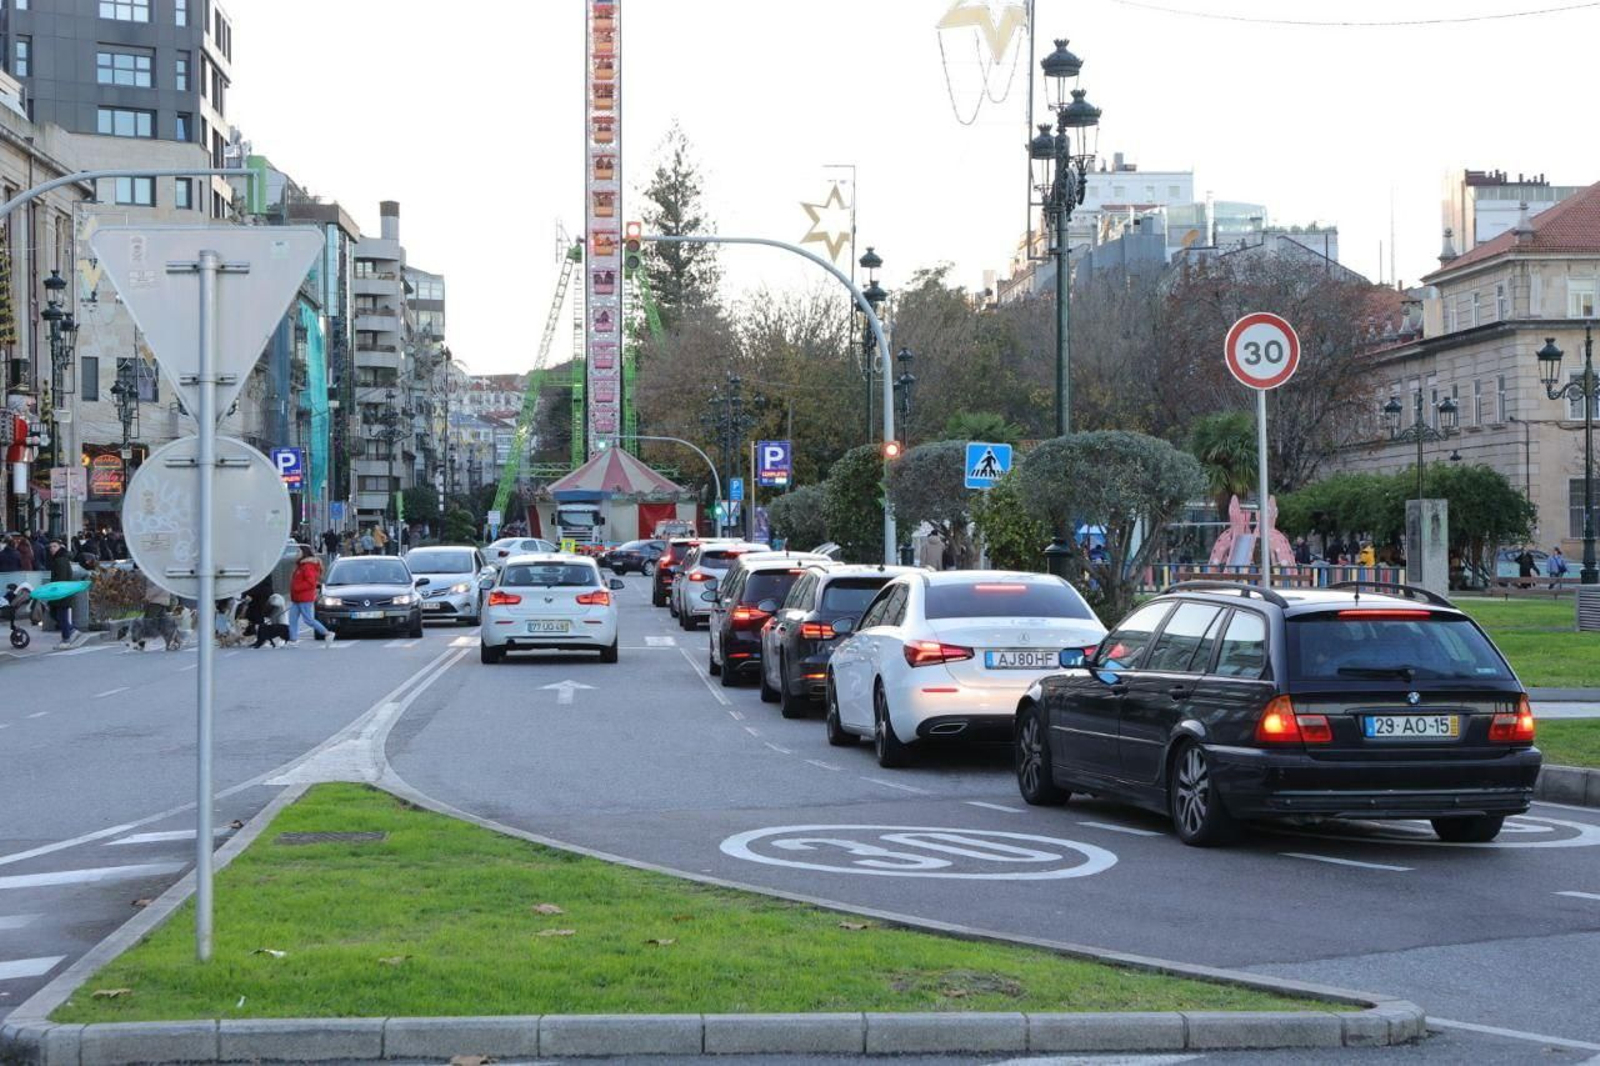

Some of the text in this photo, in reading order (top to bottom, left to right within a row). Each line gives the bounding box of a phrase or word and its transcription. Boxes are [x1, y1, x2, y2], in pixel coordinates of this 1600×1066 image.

[1244, 340, 1284, 366] 30
[276, 453, 296, 475] P
[764, 446, 784, 470] P
[998, 653, 1054, 666] AJ80HF
[770, 832, 1063, 871] 30
